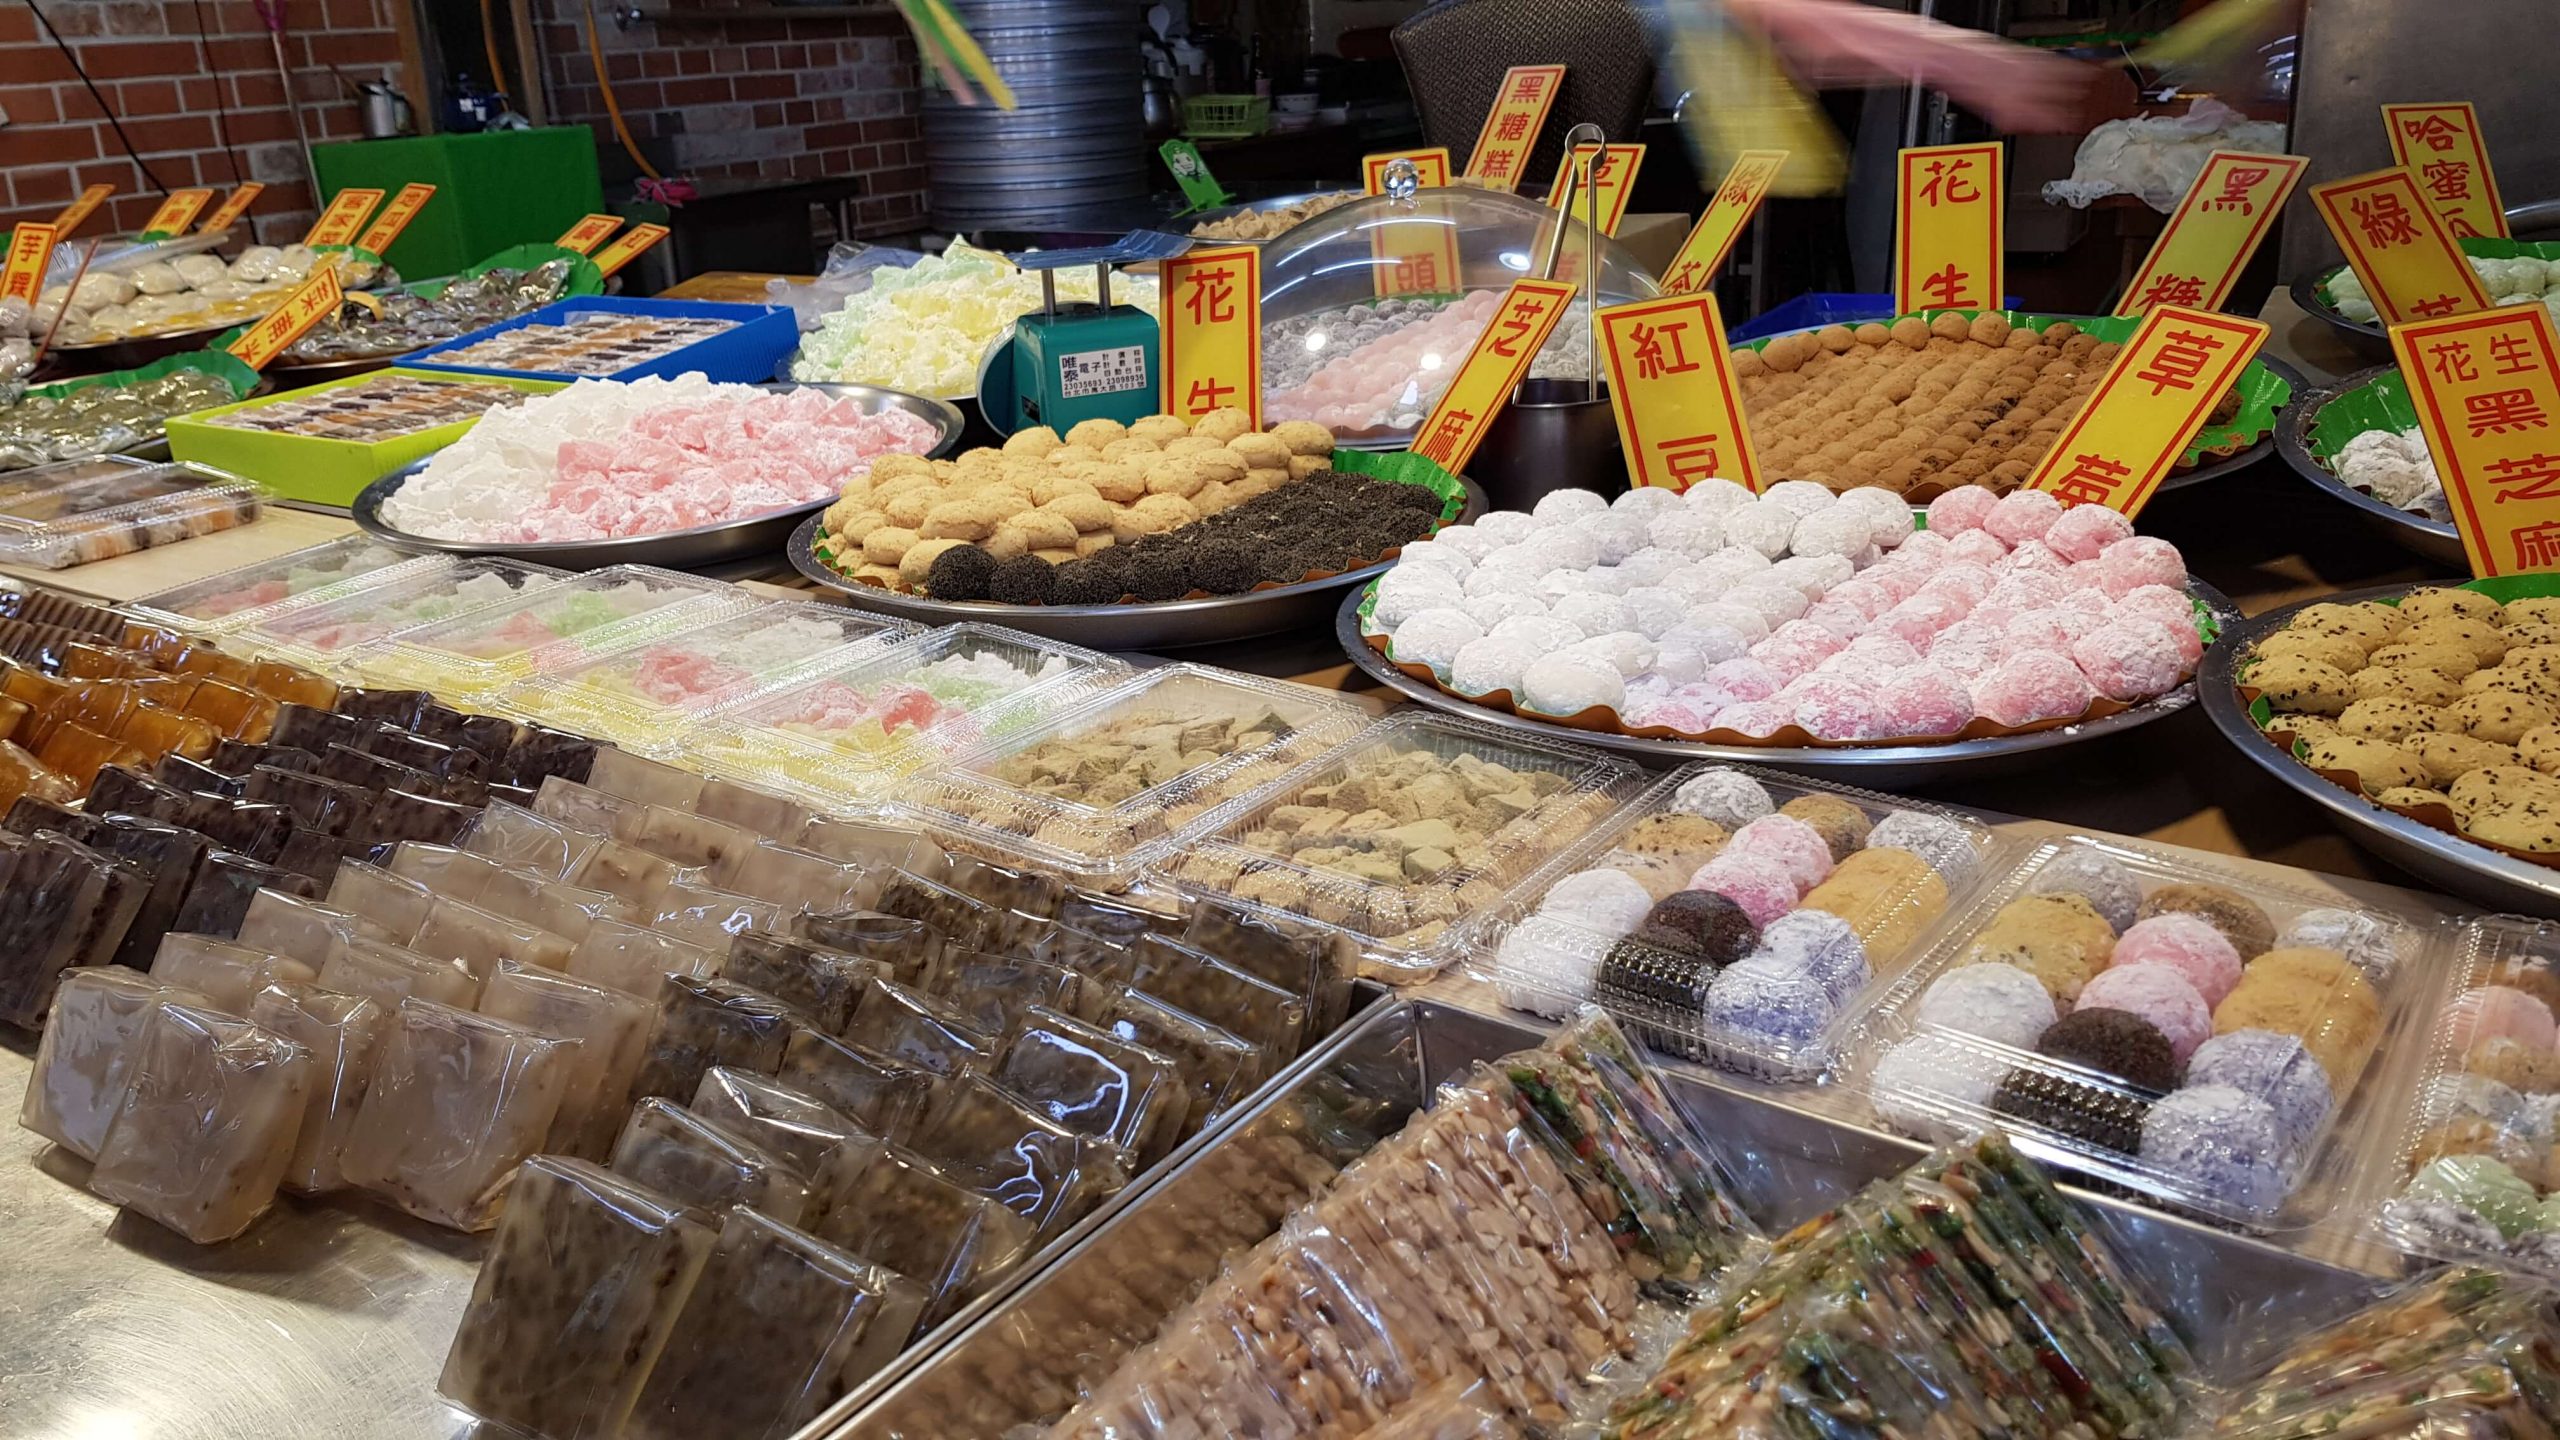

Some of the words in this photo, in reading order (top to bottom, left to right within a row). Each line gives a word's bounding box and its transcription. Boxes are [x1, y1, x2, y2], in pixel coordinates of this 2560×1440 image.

[1478, 76, 1546, 178] 黑糖糕
[1919, 159, 1980, 311] 花生
[1423, 299, 1544, 466] 芝麻
[1629, 322, 1719, 496] 紅豆
[2427, 333, 2539, 384] 花生
